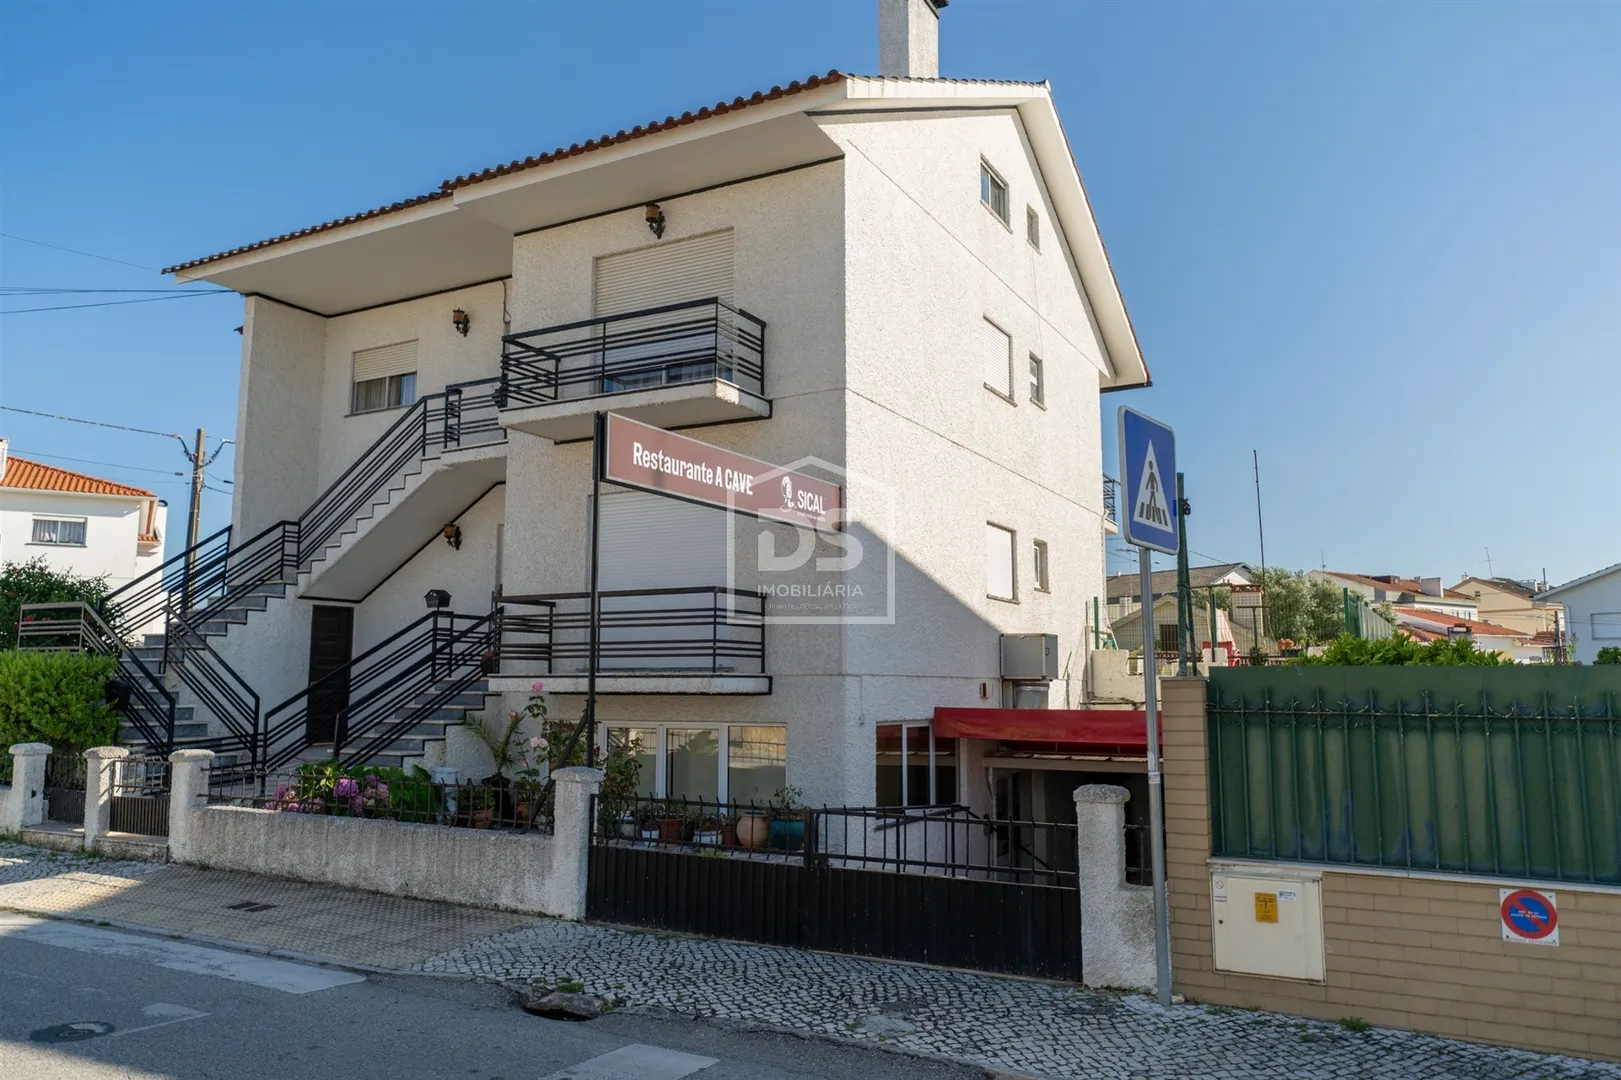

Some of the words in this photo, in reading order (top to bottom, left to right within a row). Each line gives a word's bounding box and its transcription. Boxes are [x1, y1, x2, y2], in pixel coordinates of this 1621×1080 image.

[633, 441, 713, 485] Restaurante
[715, 466, 723, 488] A
[725, 468, 753, 495] CAVE
[797, 490, 826, 515] SICAL
